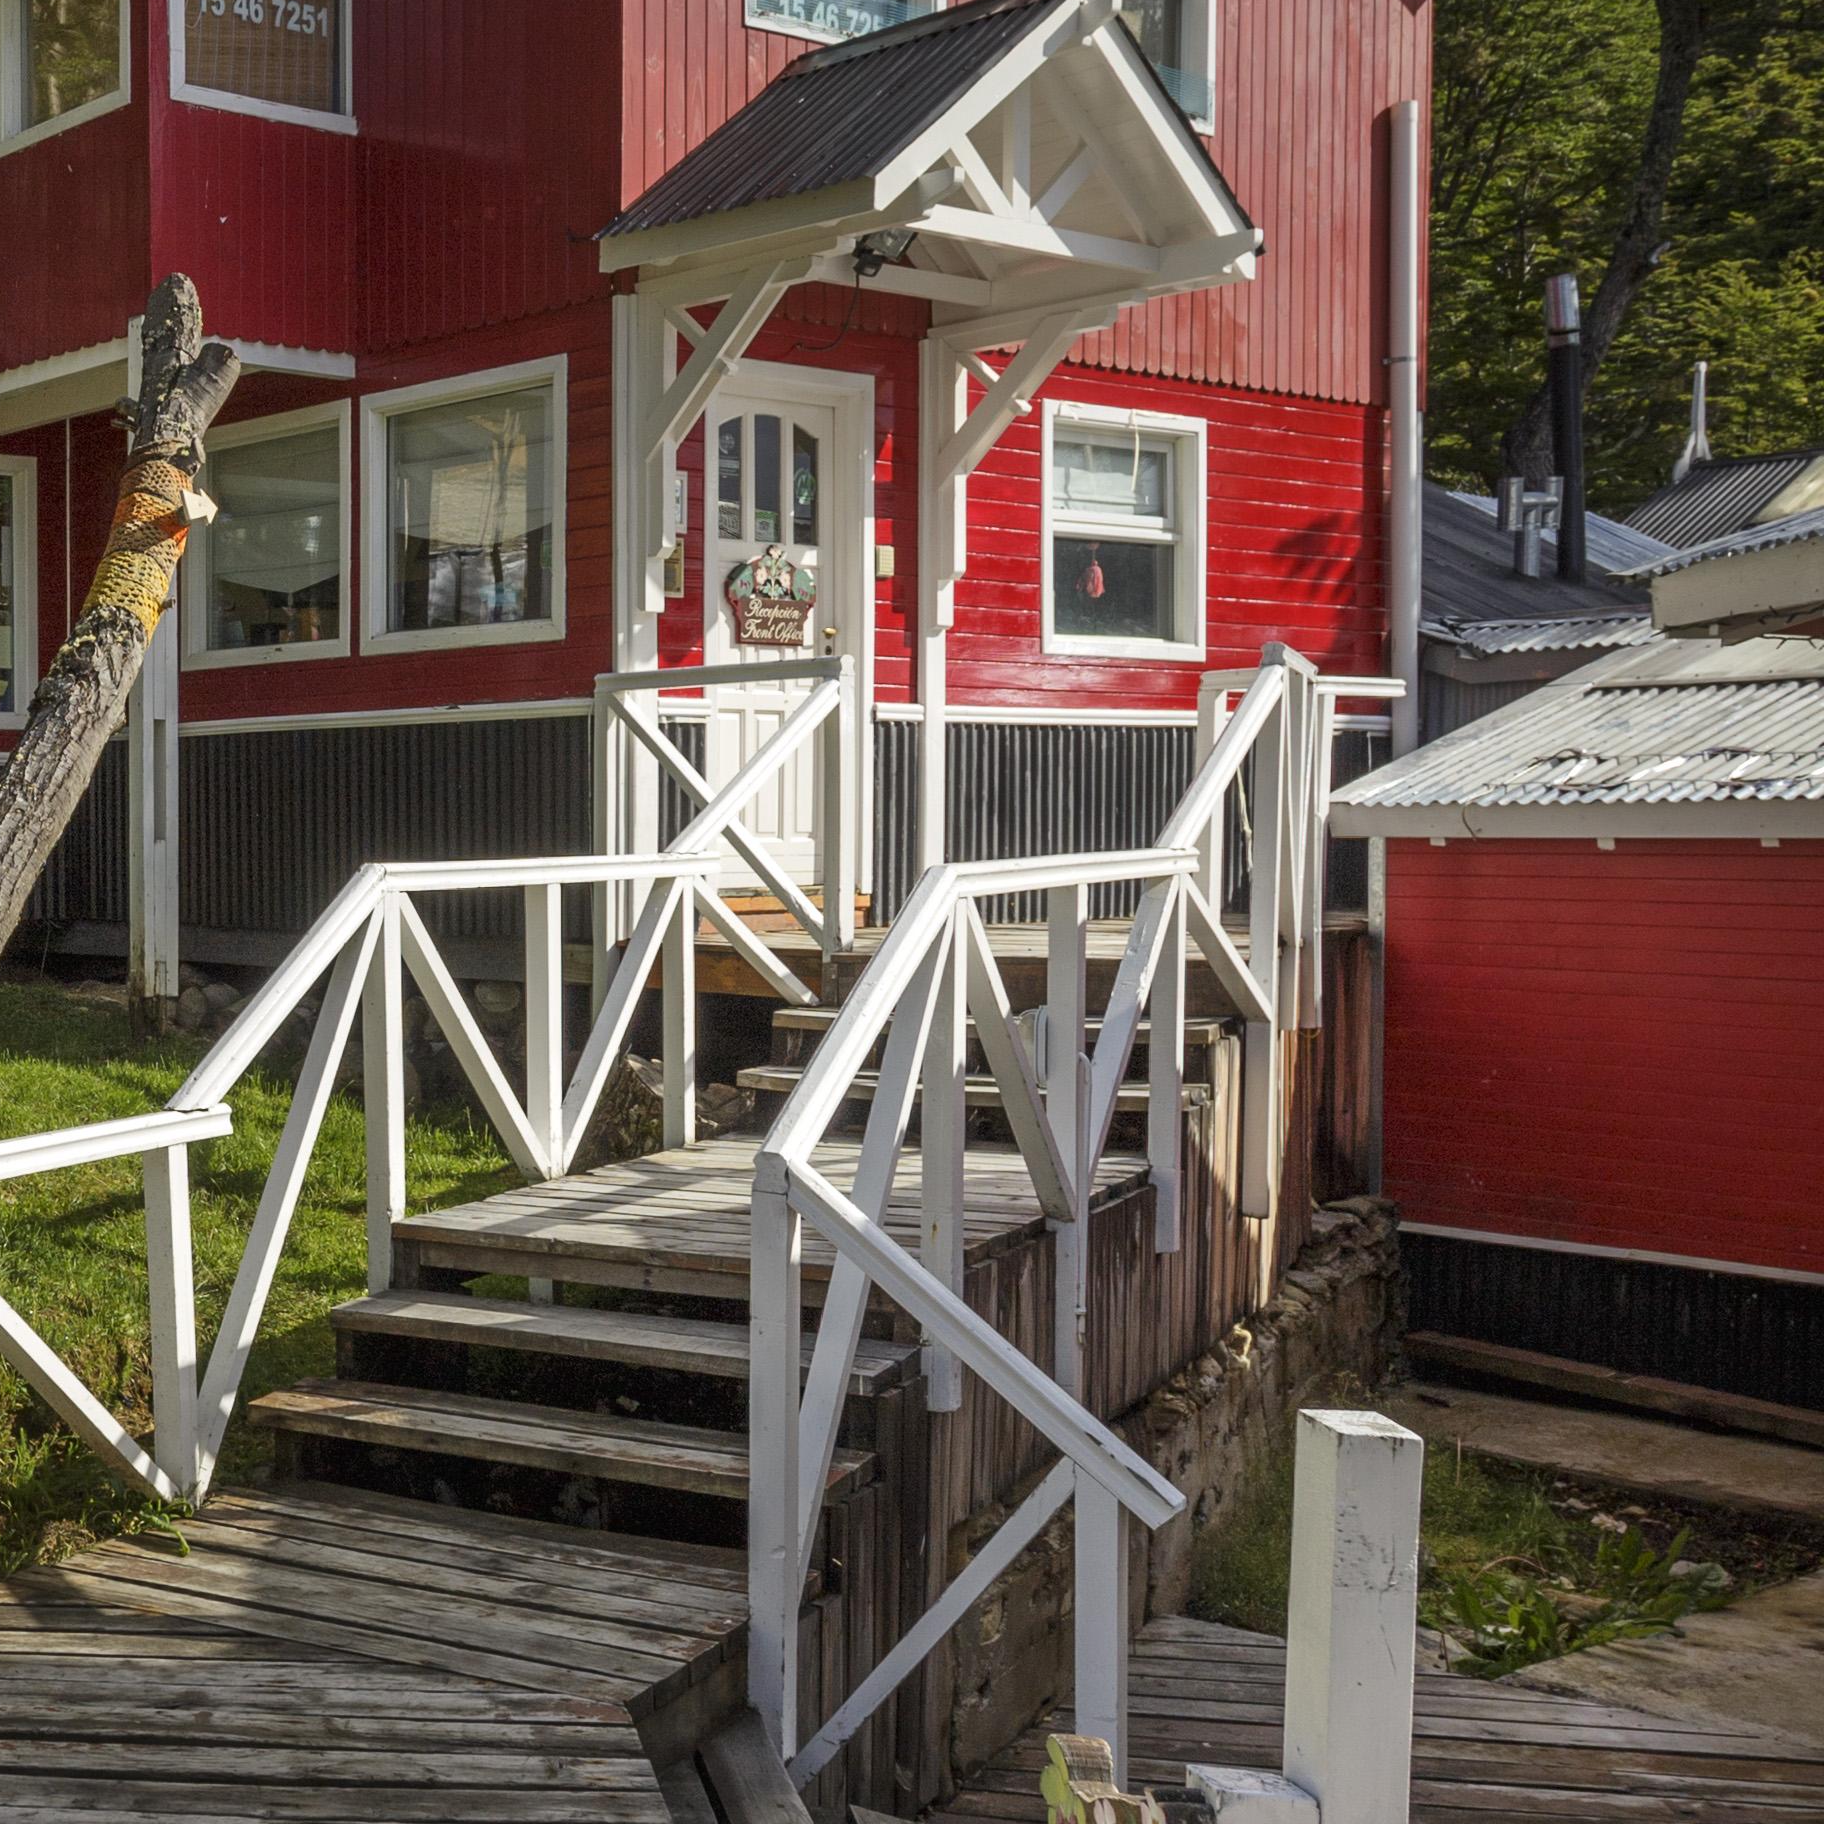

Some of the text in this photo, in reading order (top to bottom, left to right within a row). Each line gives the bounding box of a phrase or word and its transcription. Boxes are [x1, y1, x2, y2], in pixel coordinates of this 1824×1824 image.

[813, 2, 839, 32] 46
[741, 618, 804, 643] Front Office
